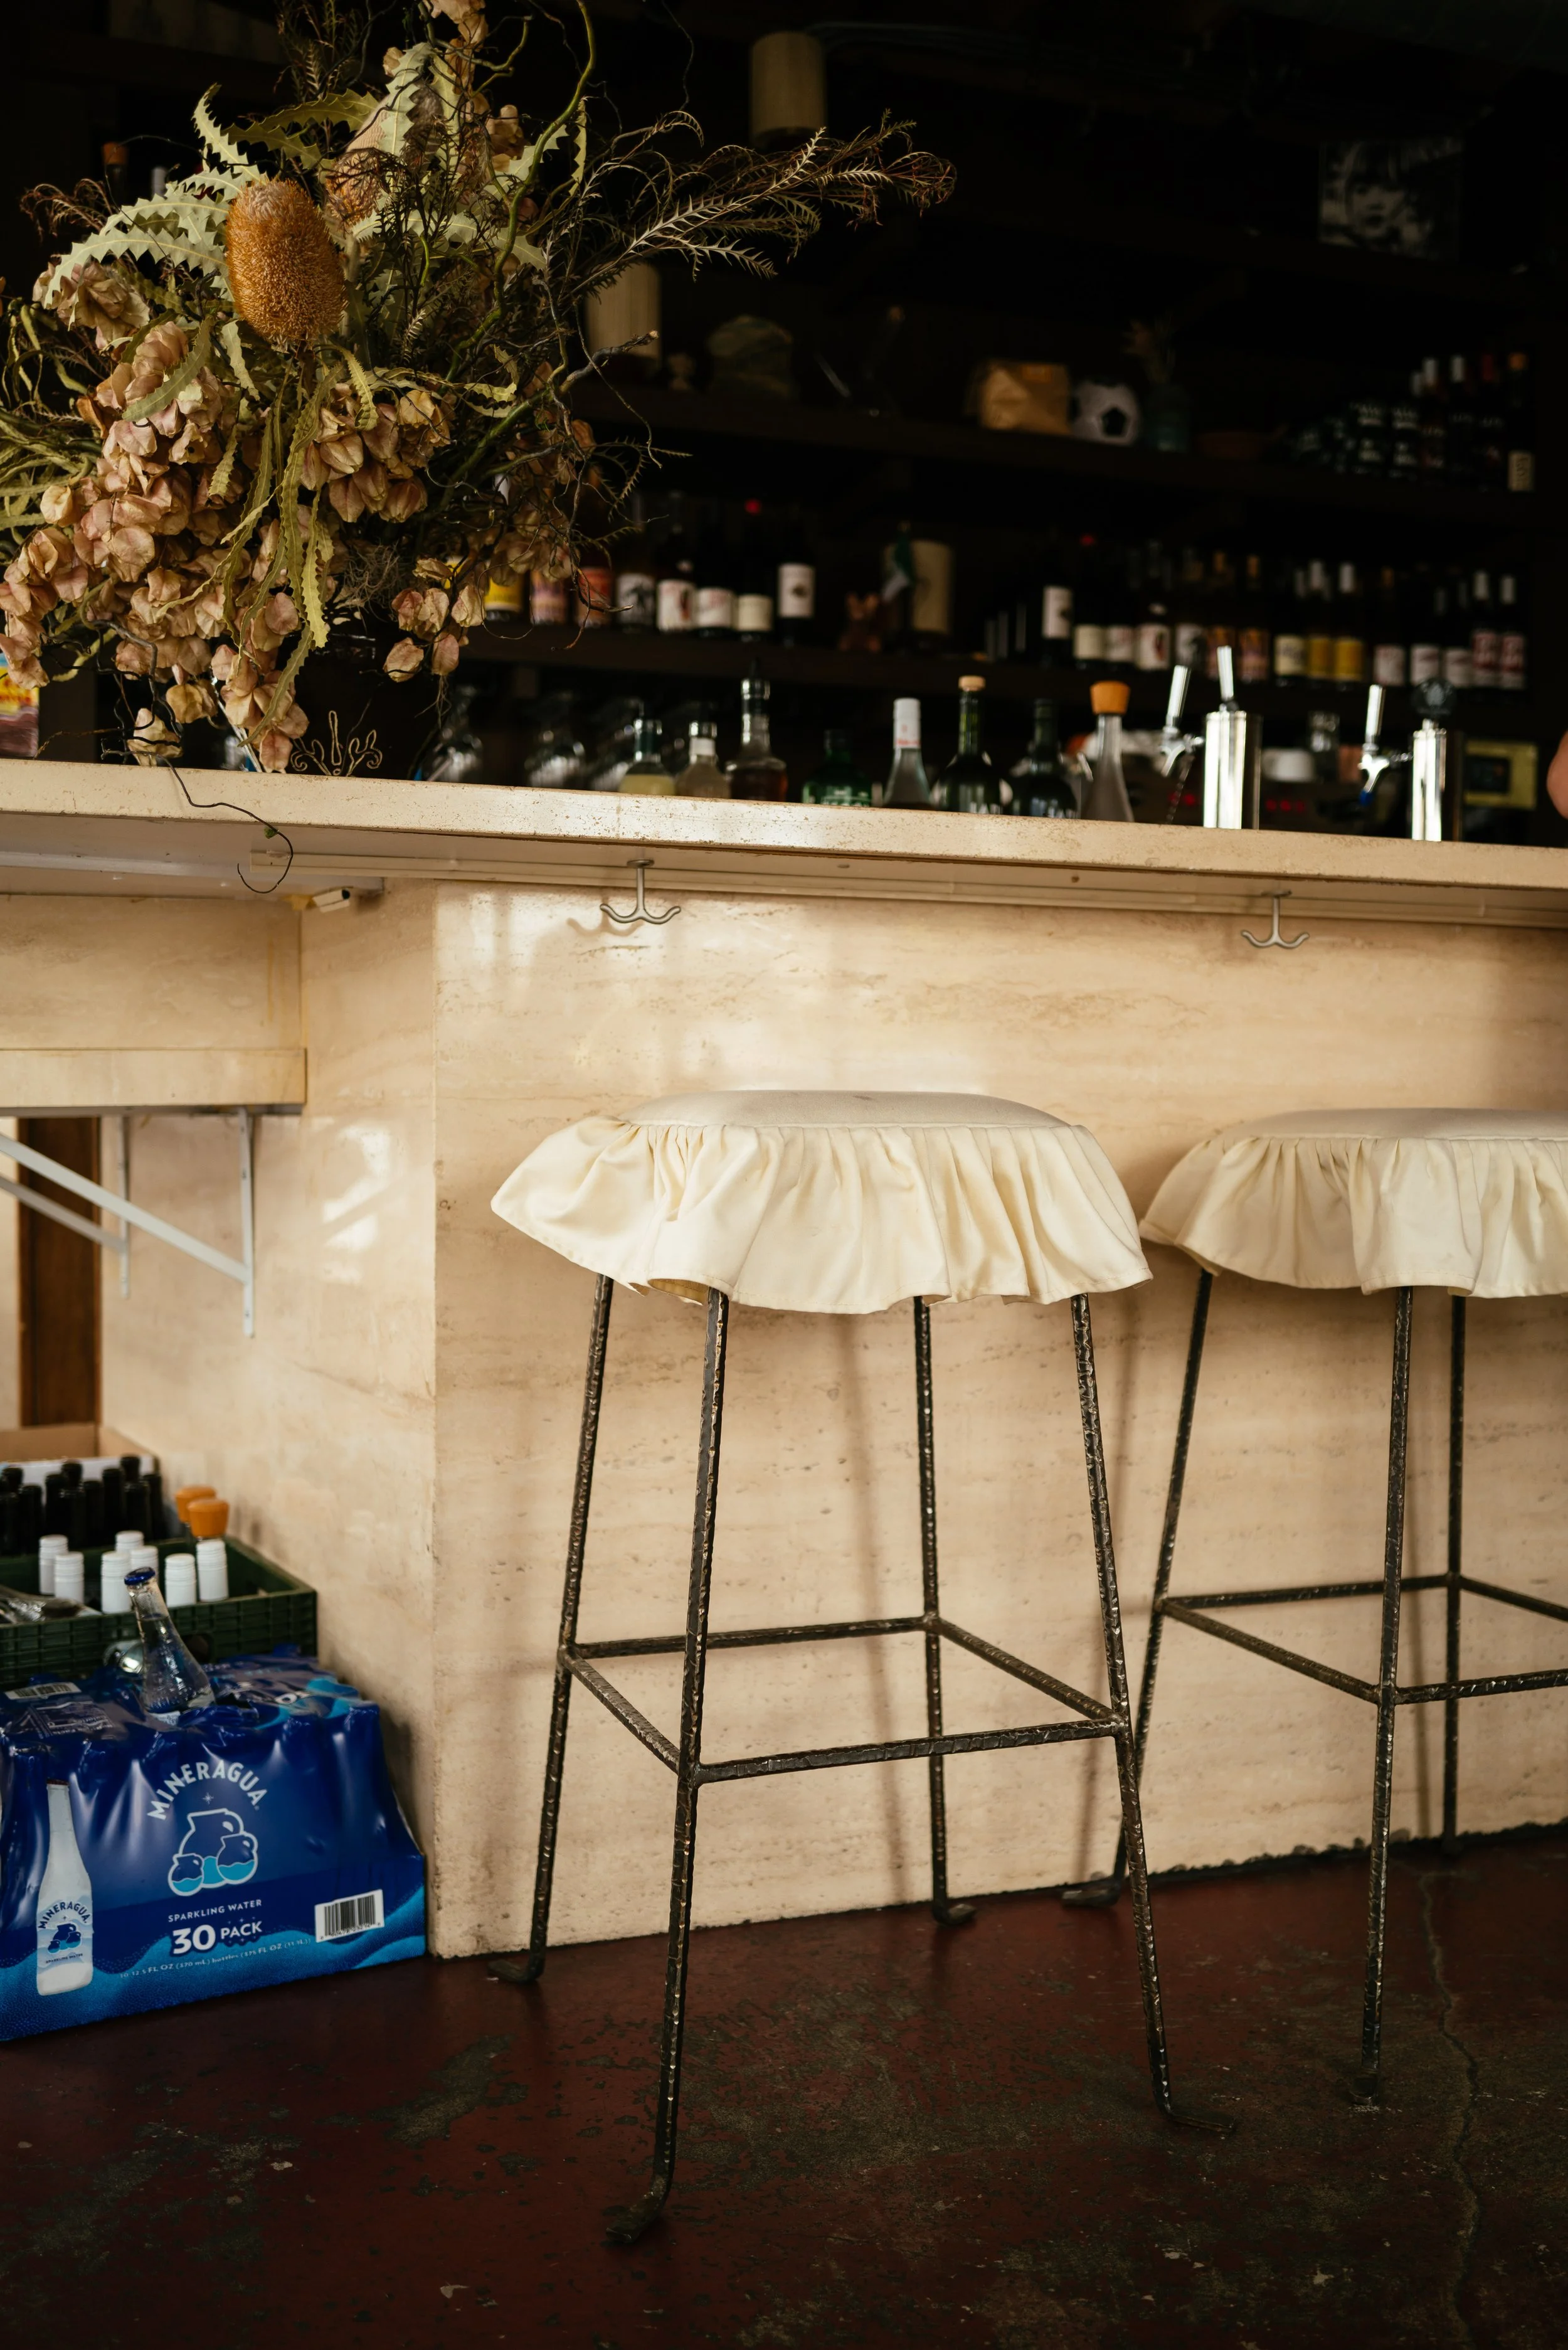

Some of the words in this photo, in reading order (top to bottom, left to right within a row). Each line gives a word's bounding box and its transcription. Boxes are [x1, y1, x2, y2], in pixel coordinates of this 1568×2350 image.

[147, 1759, 267, 1820] MINERAGUA
[38, 1901, 91, 1929] MINERAGUA
[167, 1906, 225, 1923] SPARKLING
[228, 1899, 262, 1911] WATER
[172, 1924, 216, 1955] 30
[221, 1921, 263, 1940] PACK
